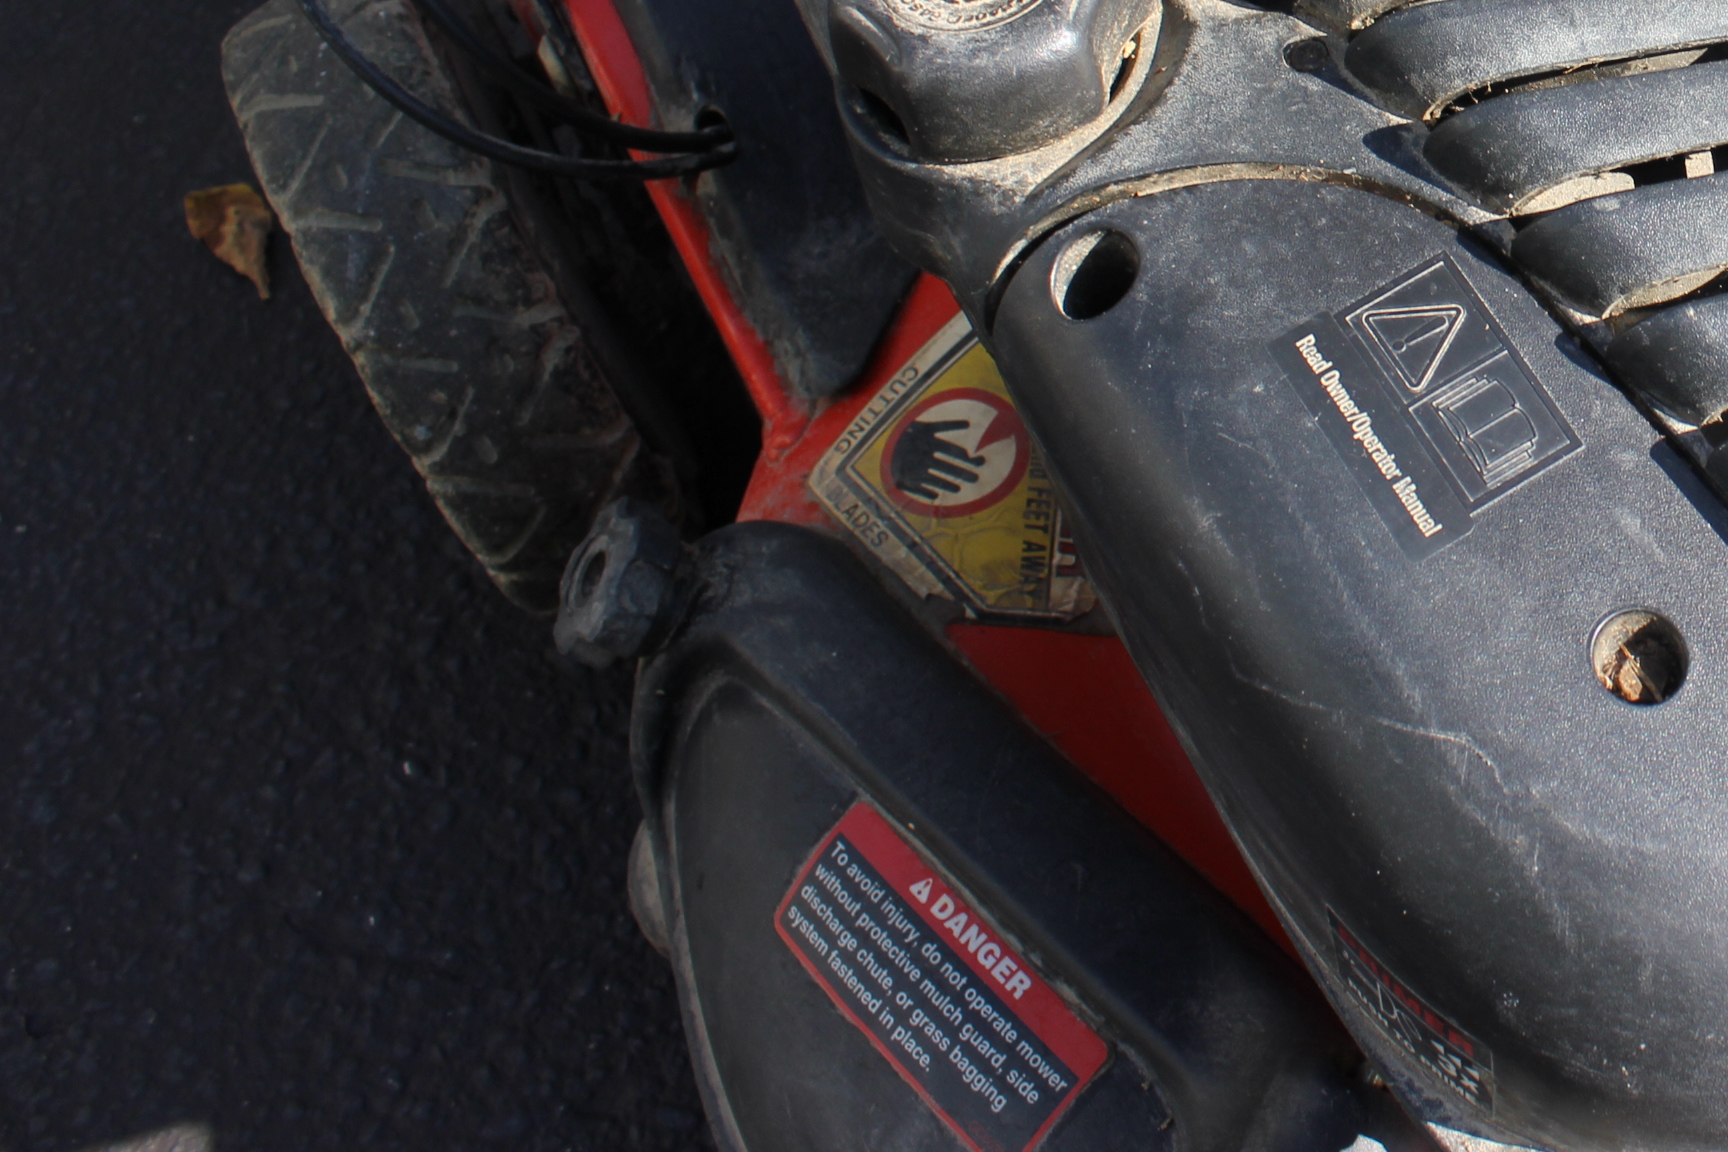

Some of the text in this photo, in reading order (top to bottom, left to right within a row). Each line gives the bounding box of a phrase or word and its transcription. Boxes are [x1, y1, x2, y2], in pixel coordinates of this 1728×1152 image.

[834, 366, 919, 455] CUTTING
[1295, 334, 1443, 538] Read Owner/Operator Manual
[825, 480, 890, 549] BLADES
[1022, 486, 1048, 536] FEET
[788, 905, 932, 1073] system fastened in place.
[801, 884, 858, 953] discharge
[856, 948, 895, 996] chute,
[895, 990, 914, 1013] or
[909, 1008, 951, 1052] grass
[948, 1043, 1007, 1114] bagging
[814, 863, 862, 918] without
[856, 911, 922, 983] protective
[920, 977, 963, 1031] mulch
[959, 1022, 1003, 1075] guard,
[1006, 1066, 1040, 1105] side
[831, 841, 1068, 1093] To avoid injury, do not operate mower
[930, 893, 1032, 1000] DANGER
[1393, 1028, 1416, 1054] TO
[1420, 1054, 1476, 1107] PRIME
